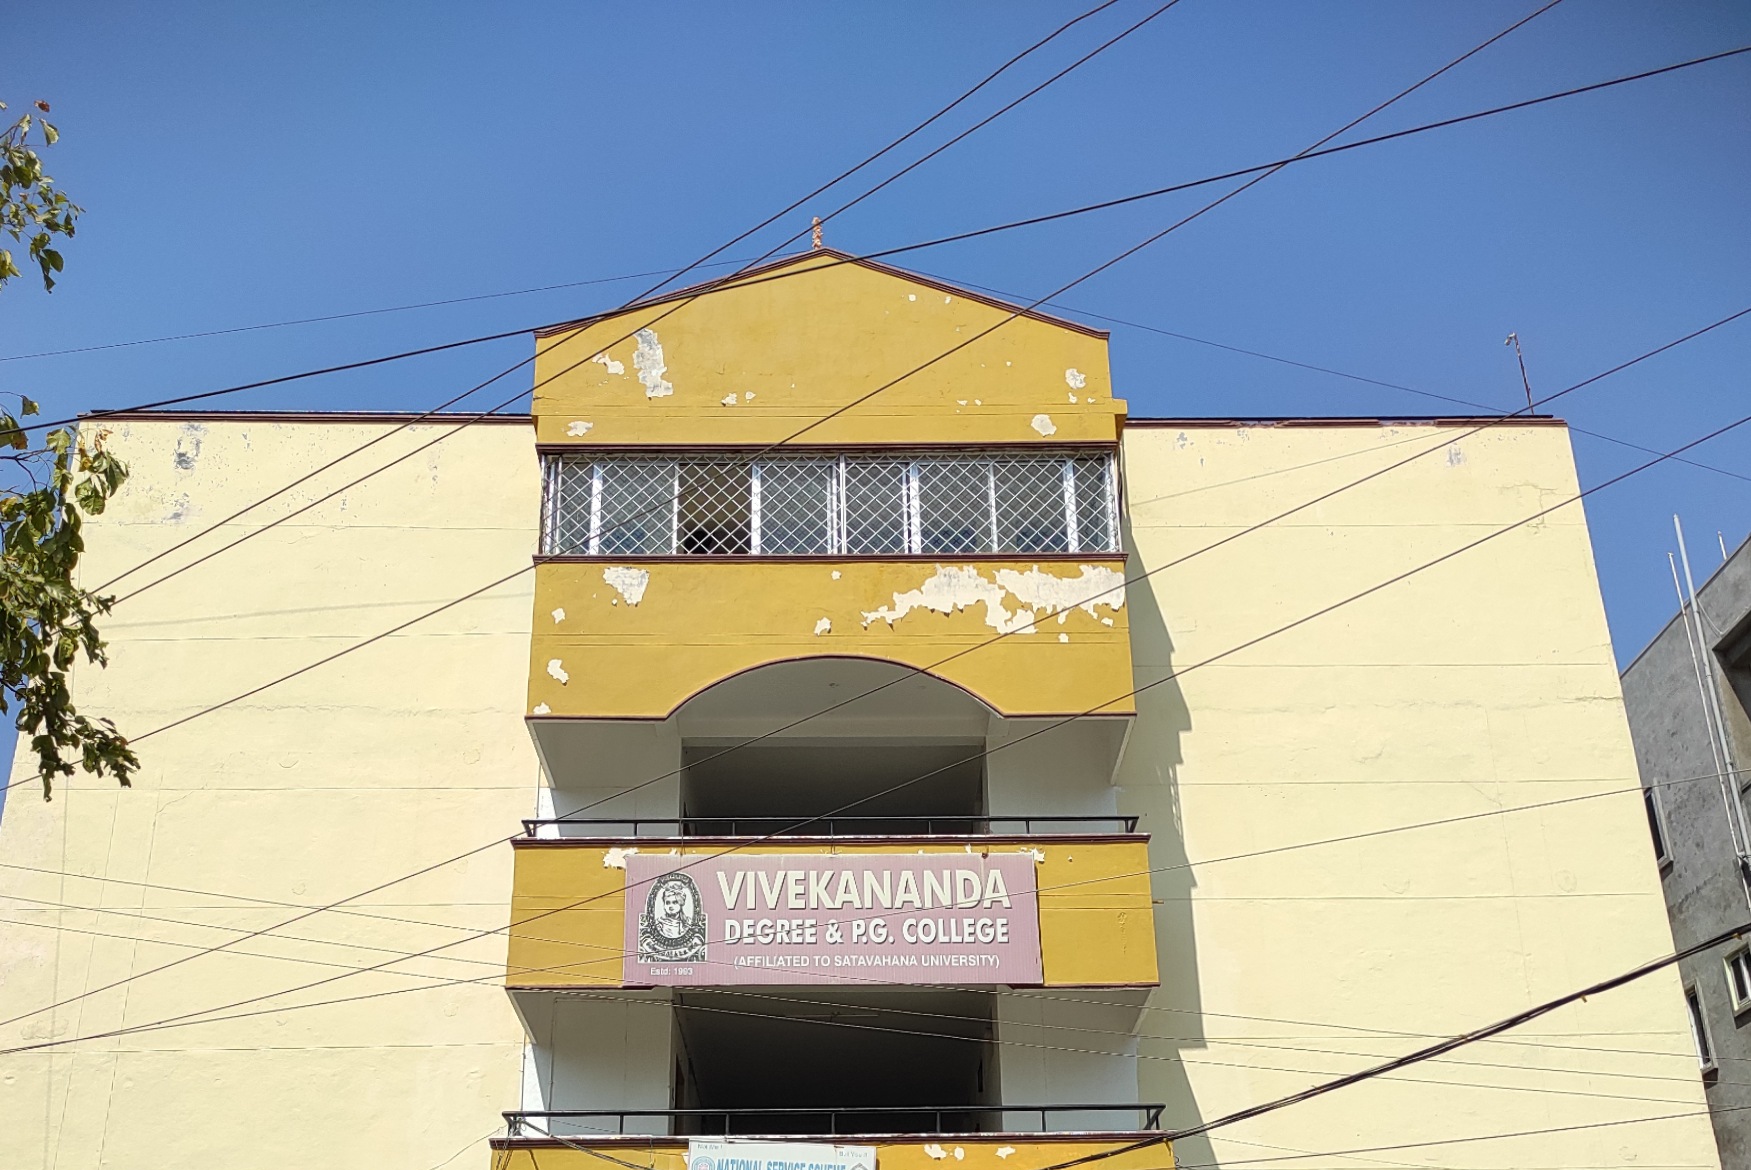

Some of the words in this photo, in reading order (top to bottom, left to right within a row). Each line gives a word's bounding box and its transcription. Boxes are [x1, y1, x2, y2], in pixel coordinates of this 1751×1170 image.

[716, 869, 1012, 910] VIVEKANANDA
[725, 918, 817, 945] DEGREE
[825, 918, 844, 945] &
[852, 918, 895, 944] P.G.
[902, 917, 1010, 944] COLLEGE
[734, 955, 810, 970] (AFFILIATED
[813, 955, 831, 967] TO
[834, 955, 918, 967] SATAVAHANA
[921, 954, 1000, 968] UNIVERSITY)
